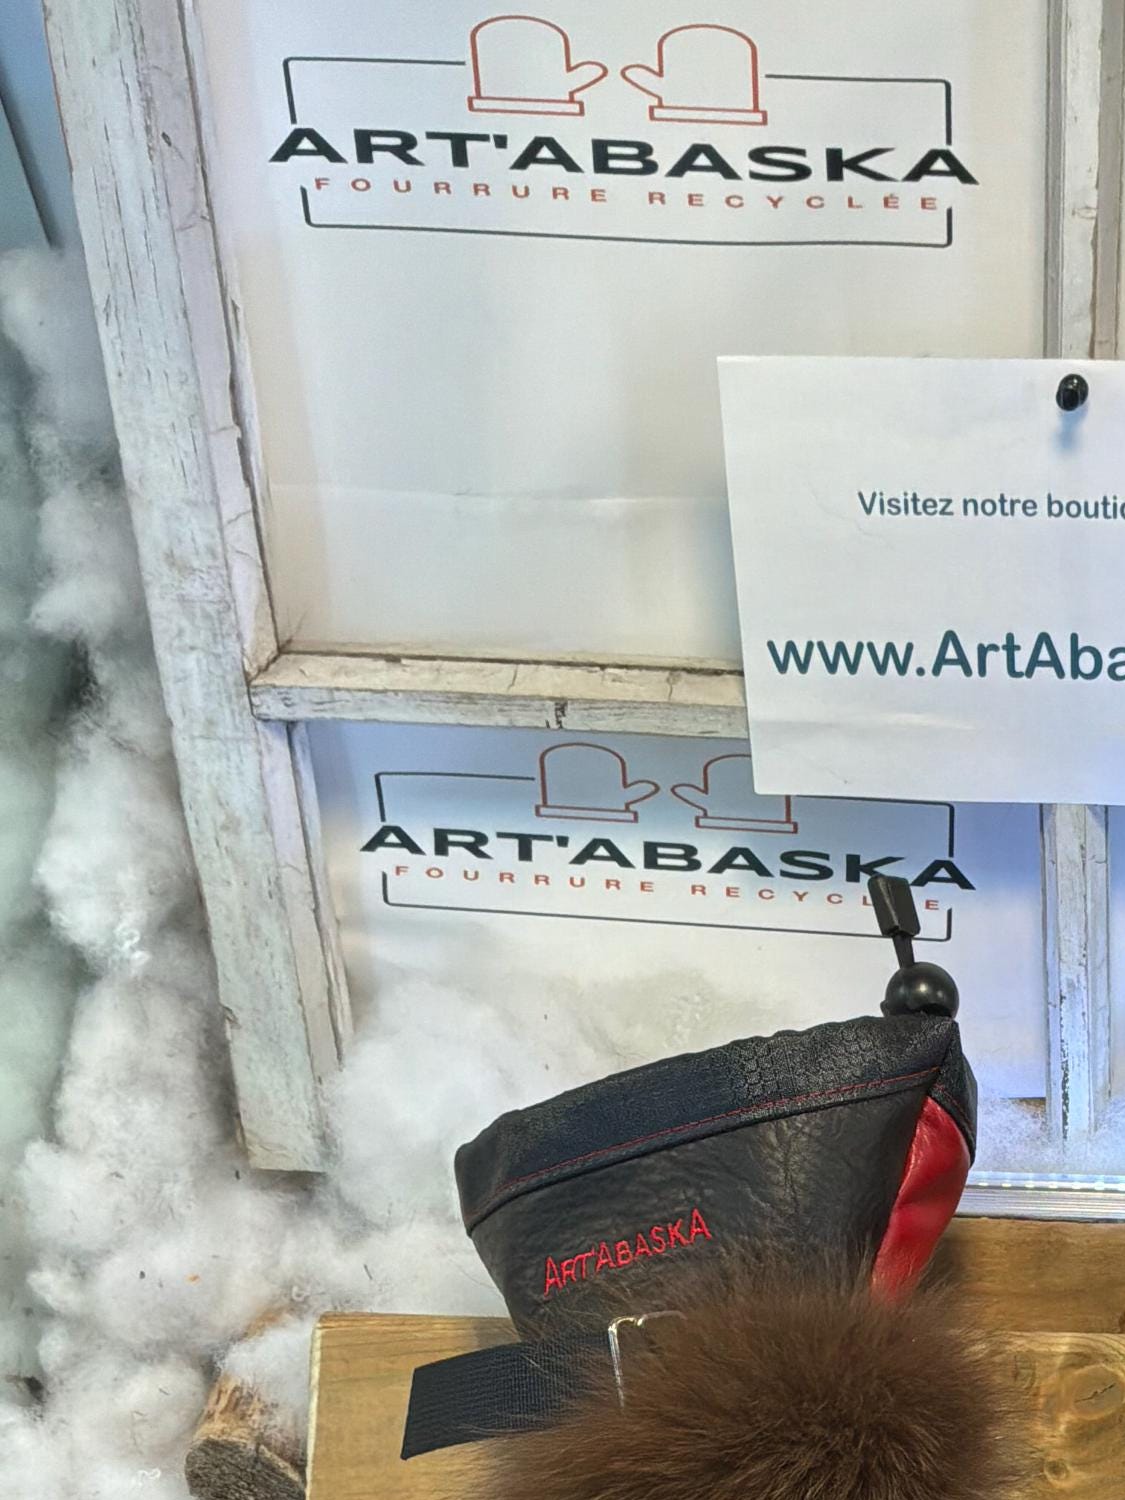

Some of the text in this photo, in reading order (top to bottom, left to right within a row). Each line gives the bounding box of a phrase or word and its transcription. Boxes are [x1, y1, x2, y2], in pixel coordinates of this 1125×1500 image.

[269, 126, 979, 186] ART'ABASKA
[314, 176, 940, 211] FOURRURE RECYCLÉE
[857, 490, 954, 517] Visitez
[962, 492, 1038, 518] notre
[360, 824, 977, 891] ART'ABASKA
[395, 865, 940, 911] FOURRURE RECYCLE
